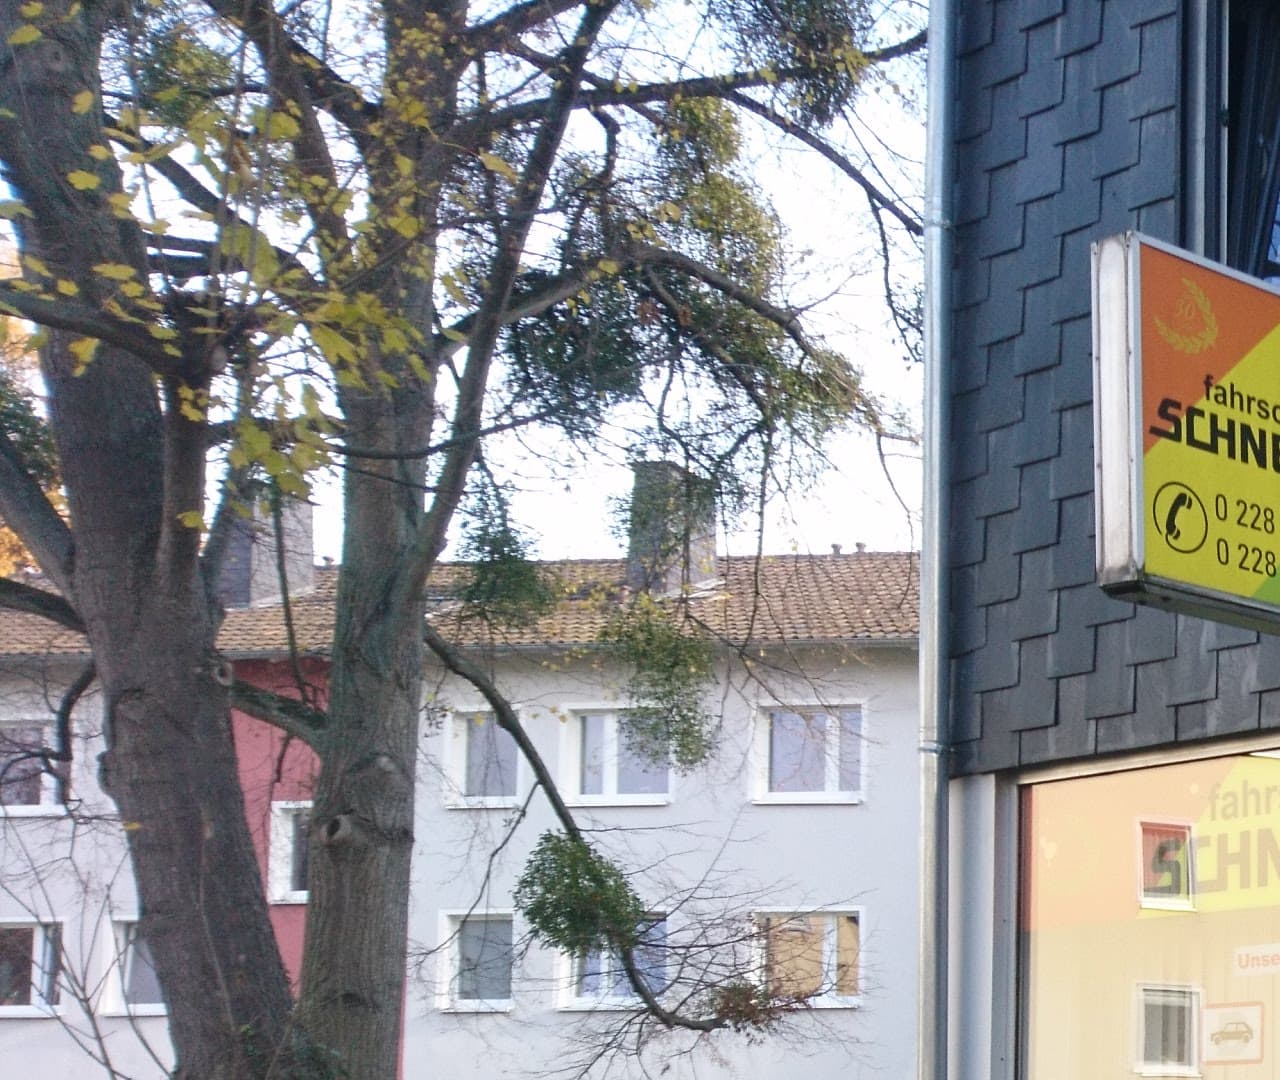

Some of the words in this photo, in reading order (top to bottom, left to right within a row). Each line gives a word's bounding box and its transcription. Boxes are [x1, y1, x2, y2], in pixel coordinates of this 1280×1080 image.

[1215, 494, 1228, 522] 0
[1236, 499, 1276, 536] 228
[1216, 537, 1230, 566] 0
[1237, 543, 1277, 578] 228
